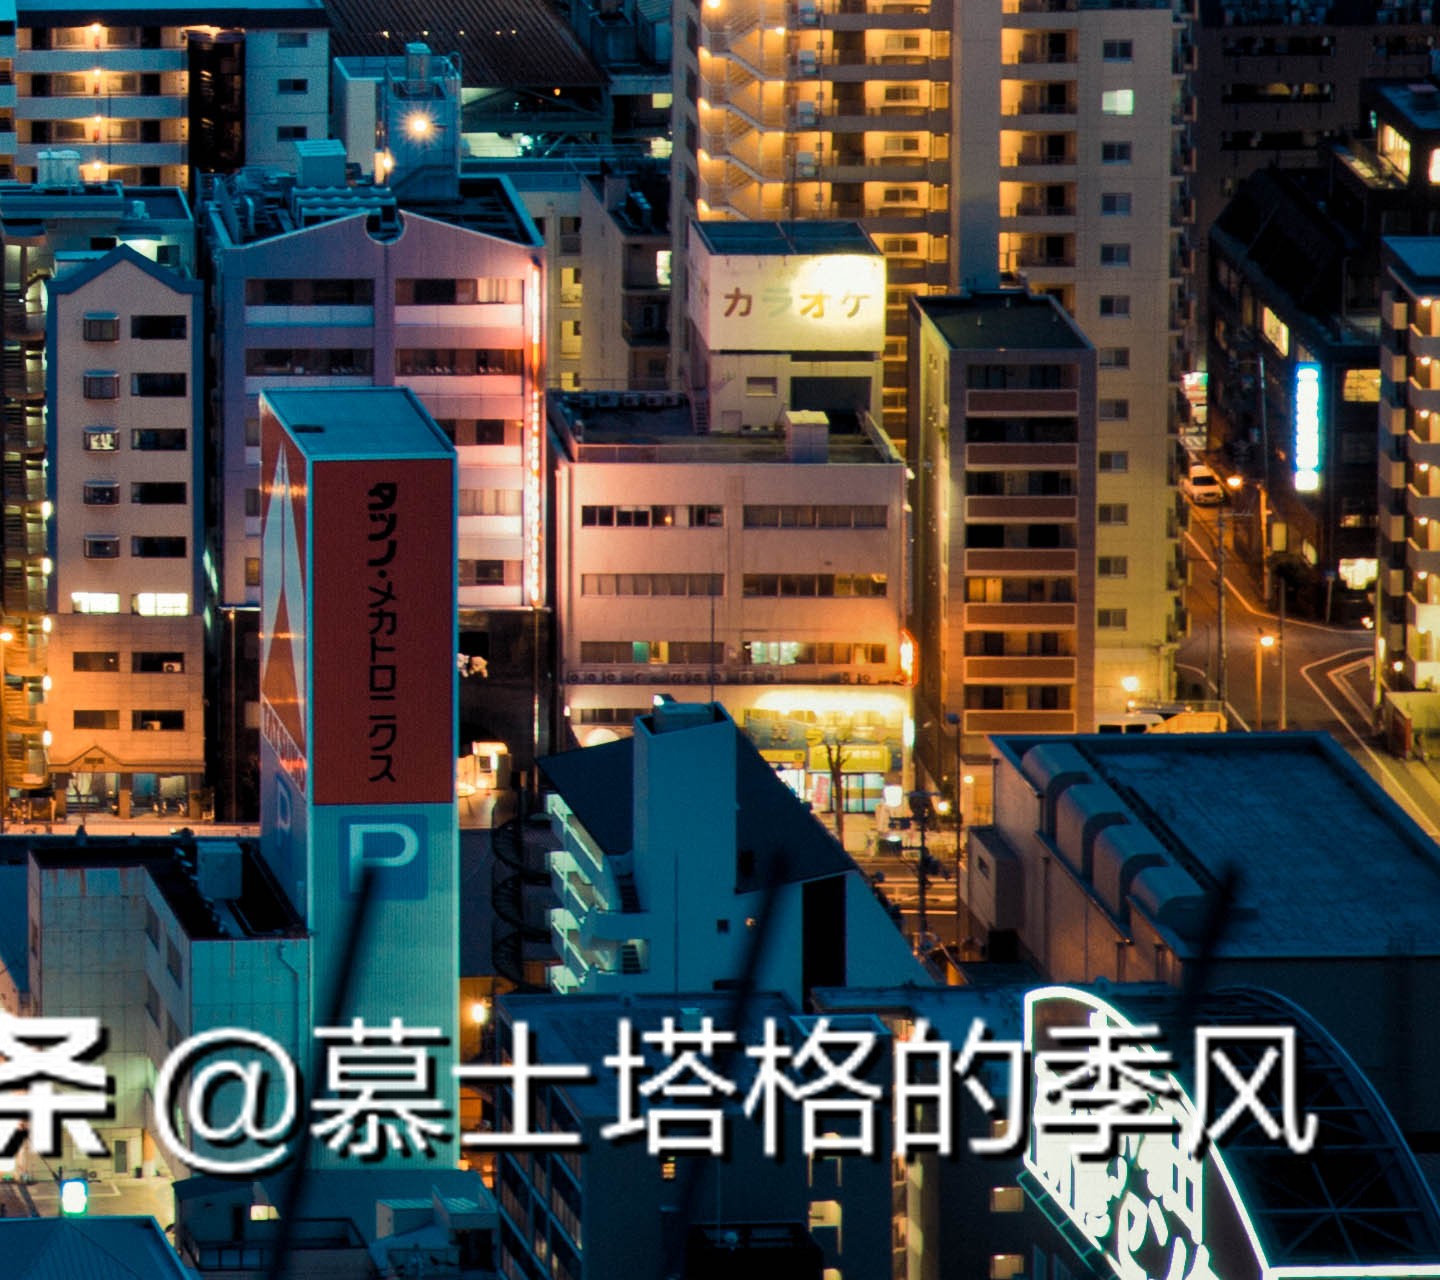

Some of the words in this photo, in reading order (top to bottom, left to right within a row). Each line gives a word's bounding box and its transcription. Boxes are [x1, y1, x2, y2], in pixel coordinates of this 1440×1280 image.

[723, 287, 871, 319] カラオケ
[348, 823, 420, 894] P
